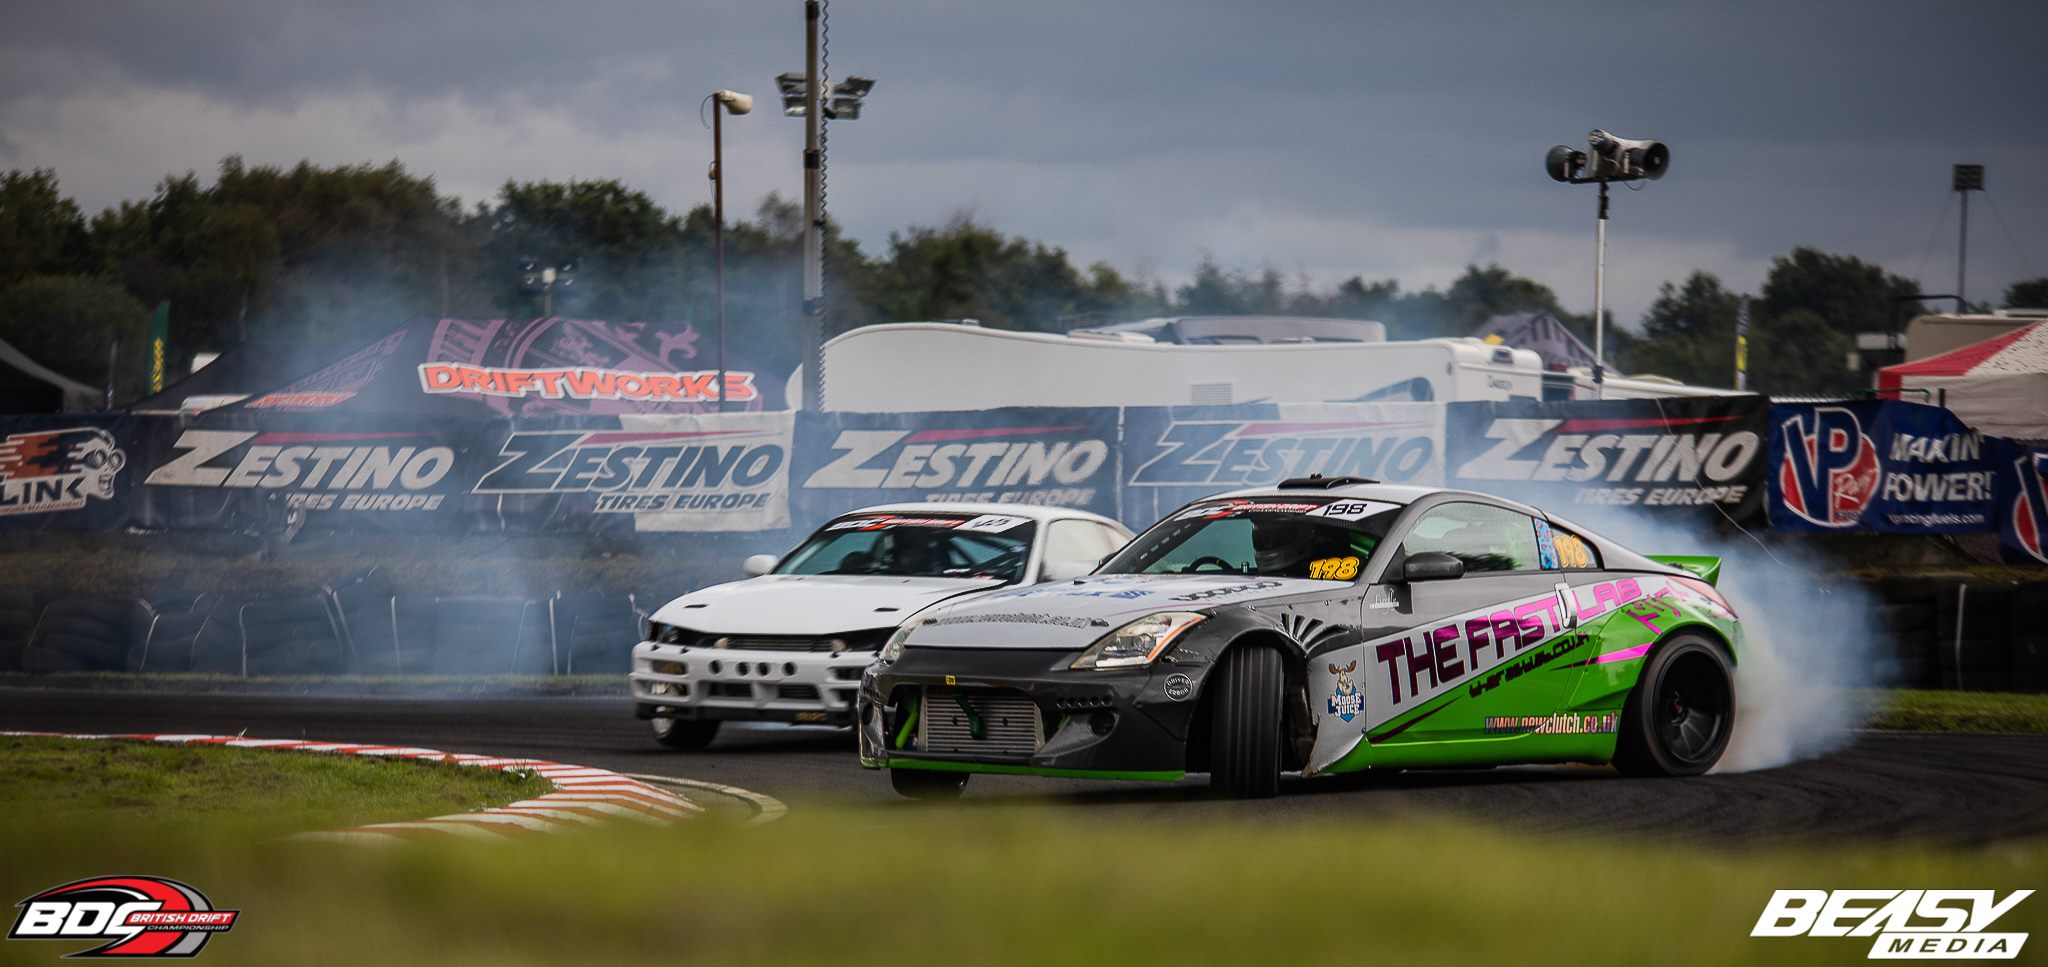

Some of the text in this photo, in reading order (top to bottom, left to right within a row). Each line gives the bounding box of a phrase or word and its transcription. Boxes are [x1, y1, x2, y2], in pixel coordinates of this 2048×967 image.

[418, 361, 759, 402] DRIFTWORKS
[143, 430, 456, 489] ZESTINO
[470, 430, 786, 494] ZESTINO
[802, 430, 1108, 489] ZESTINO
[1128, 420, 1434, 487] ZESTINO
[1455, 418, 1759, 482] ZESTINO
[1644, 485, 1748, 506] EUROPE
[1882, 472, 1993, 501] POWER!
[339, 493, 445, 511] EUROPE
[593, 491, 772, 512] TIRES EUROPE
[1323, 503, 1368, 517] 198
[1552, 534, 1589, 569] 198
[1309, 556, 1360, 580] 198
[1375, 623, 1465, 706] THE
[1464, 596, 1560, 671] FAST
[1571, 578, 1642, 620] LAB
[1331, 692, 1362, 706] MOOSE
[1334, 703, 1361, 718] JUICE
[1484, 711, 1619, 735] www.newclutch.co.uk
